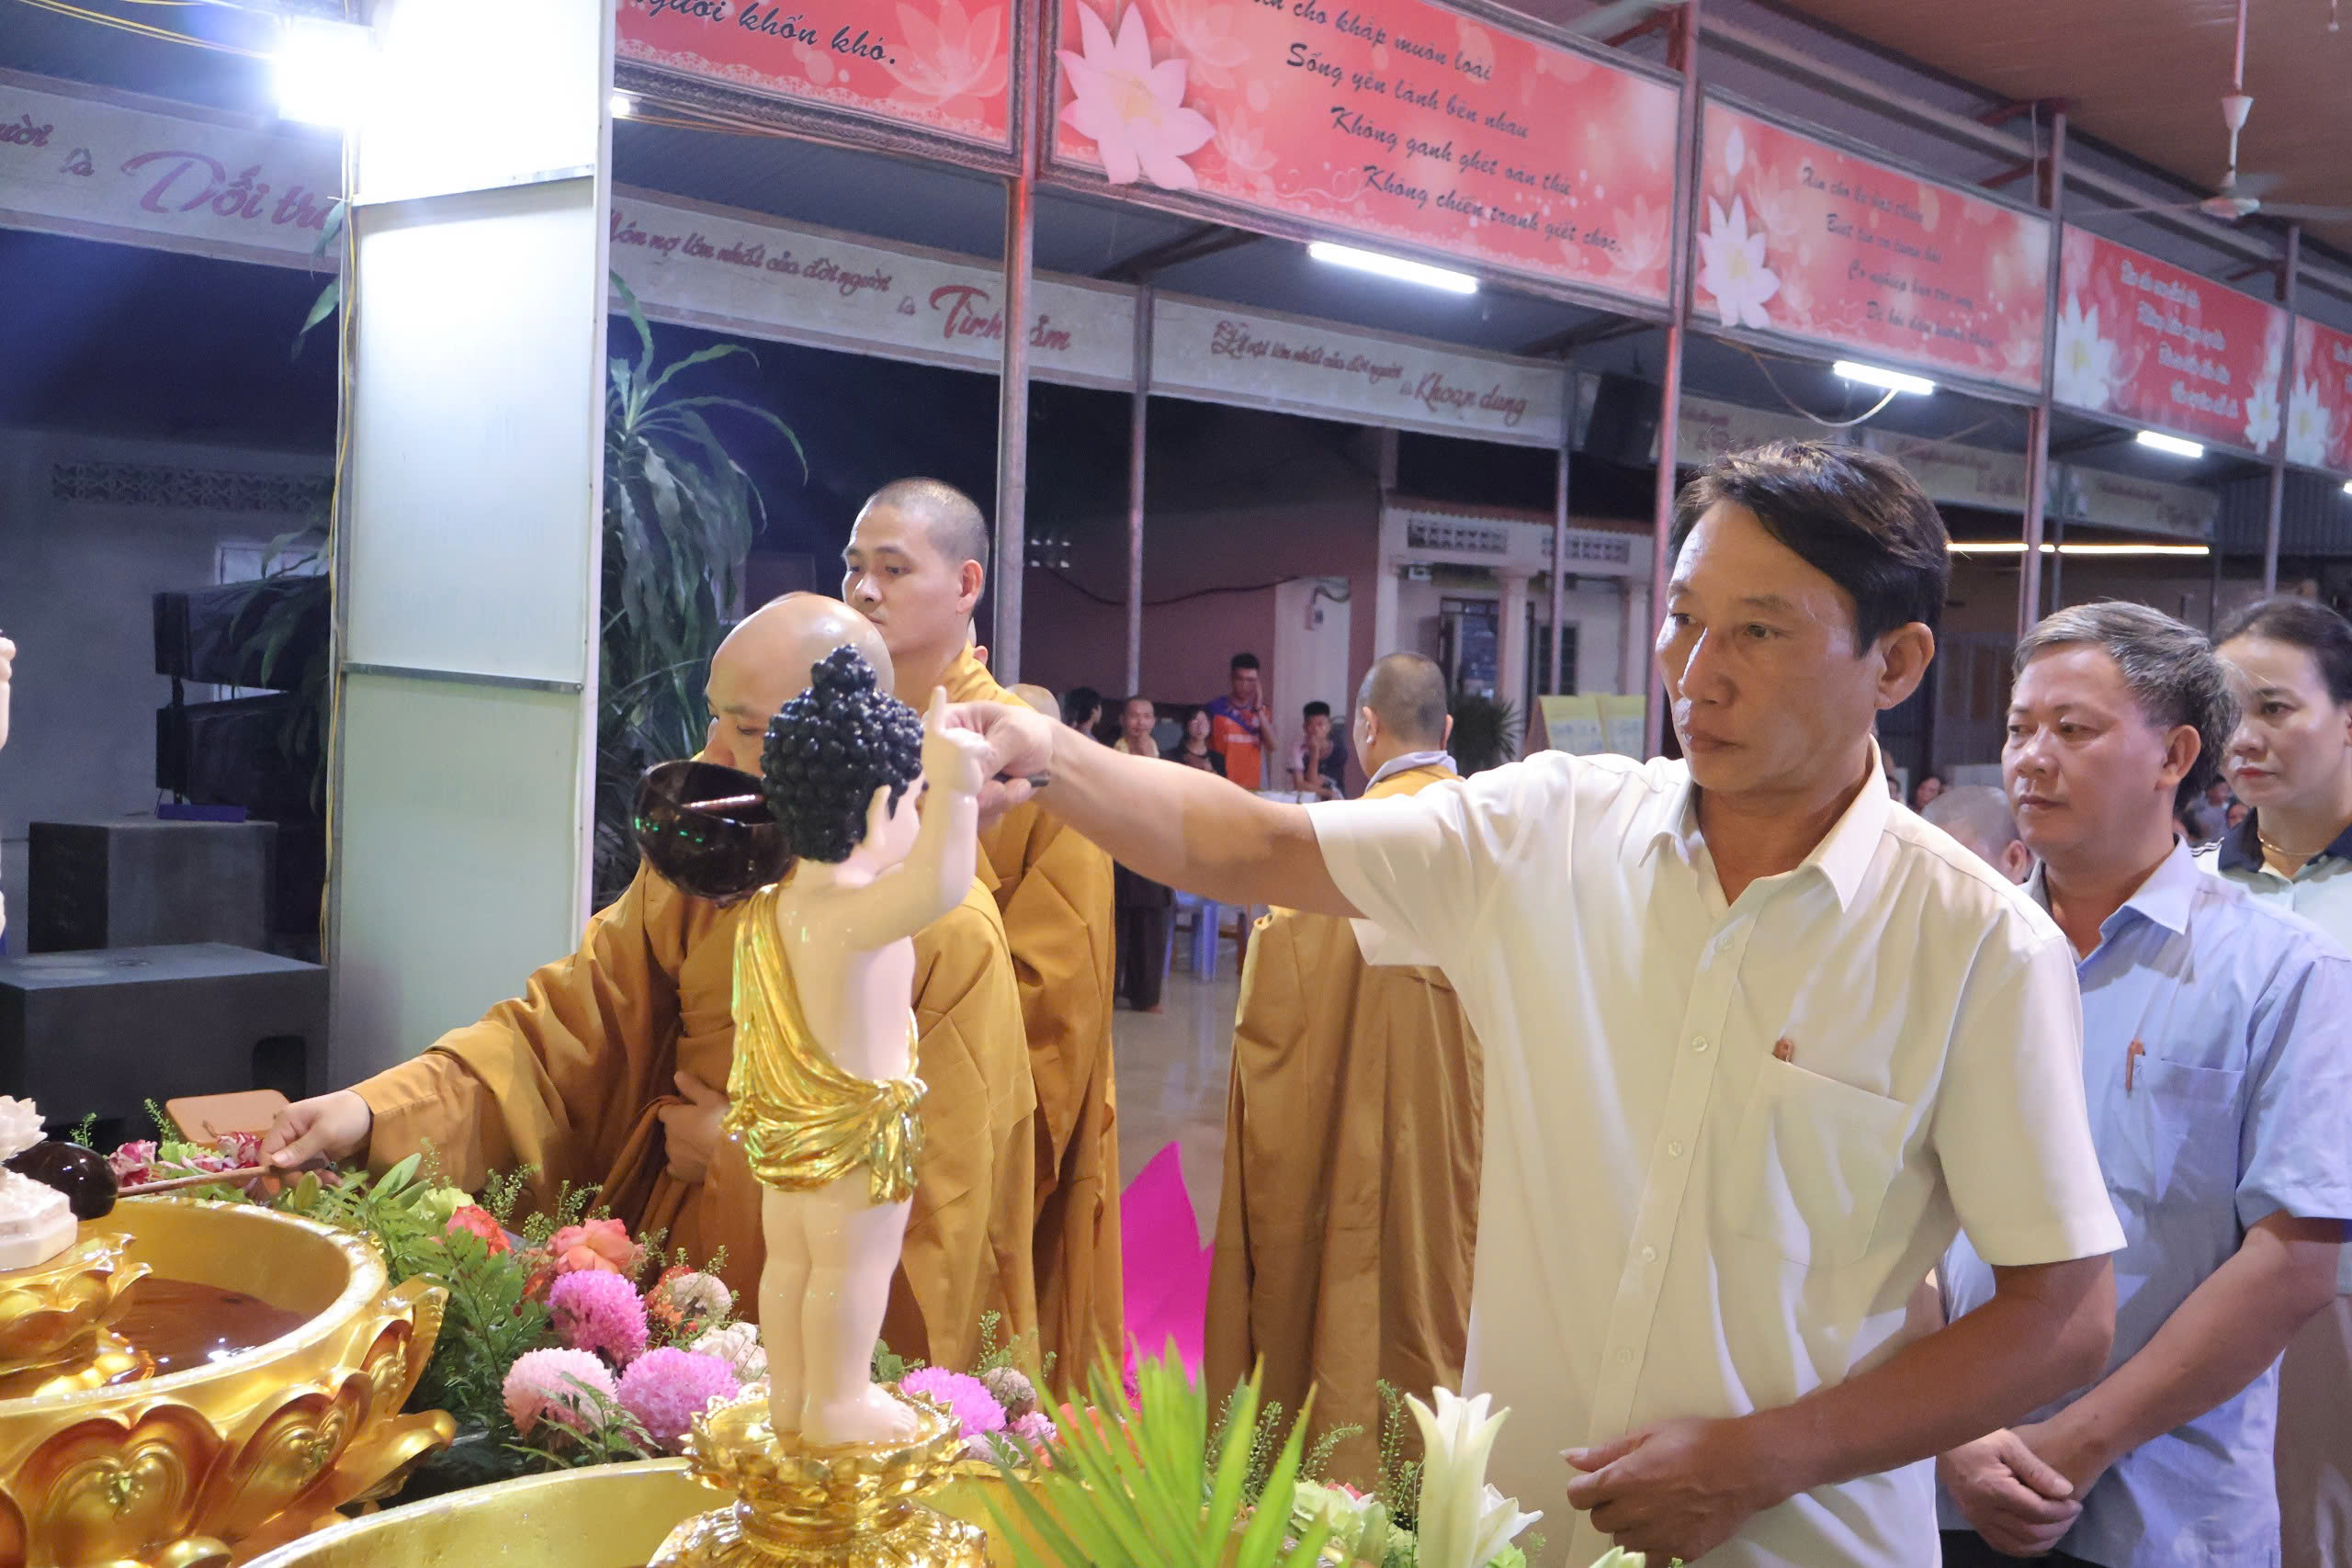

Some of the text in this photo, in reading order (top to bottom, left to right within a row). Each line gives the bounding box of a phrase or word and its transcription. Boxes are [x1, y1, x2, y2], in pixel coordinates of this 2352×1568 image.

[739, 3, 818, 45] khốn
[1293, 0, 1327, 24] cho
[1286, 43, 1343, 87] Sống
[1330, 107, 1397, 152] Không
[1363, 165, 1428, 209] Không
